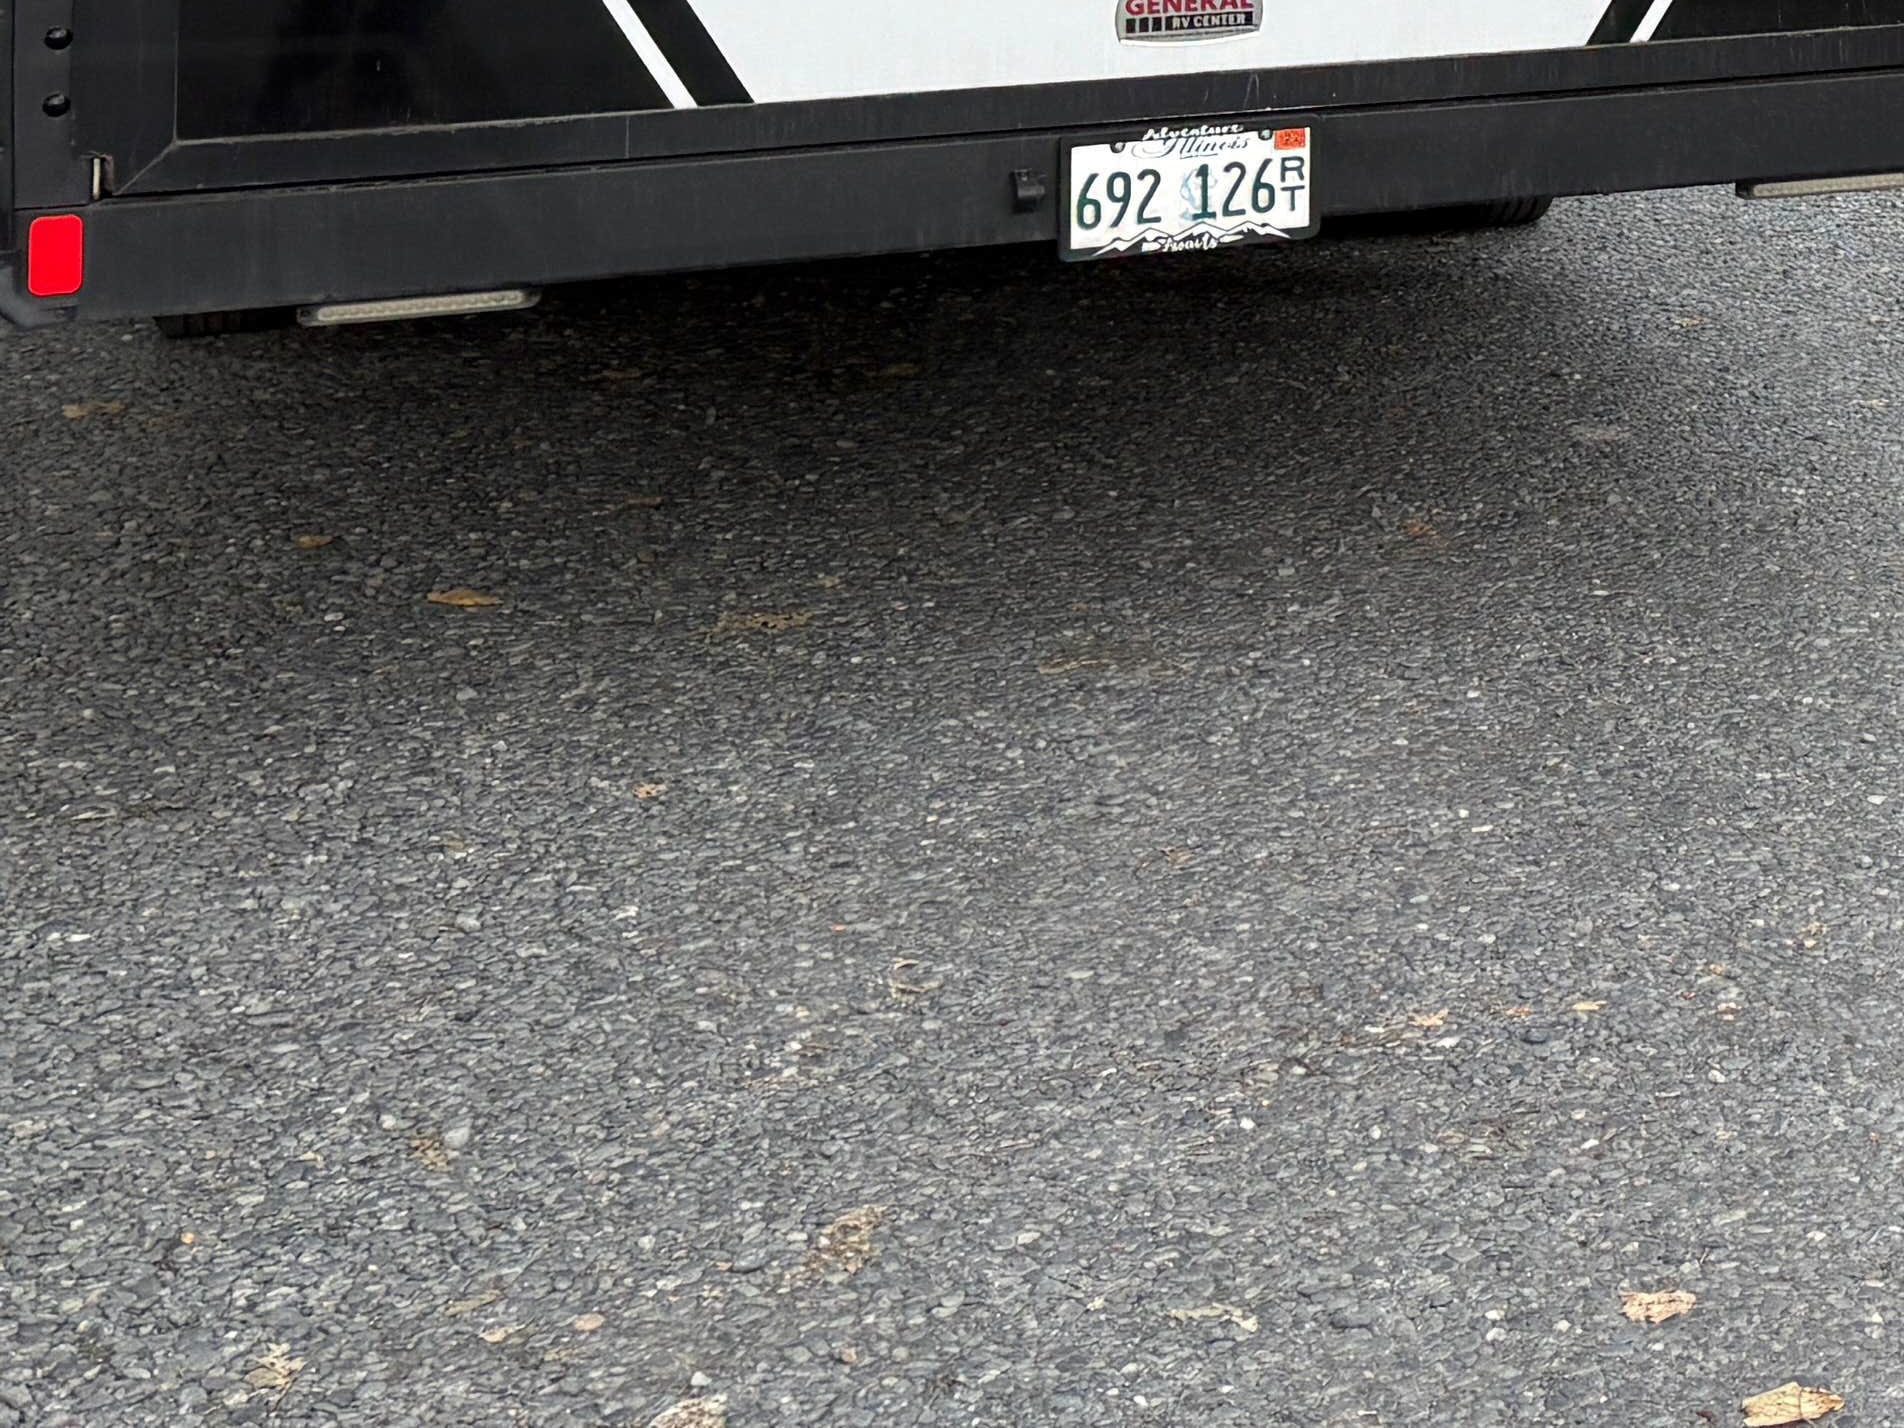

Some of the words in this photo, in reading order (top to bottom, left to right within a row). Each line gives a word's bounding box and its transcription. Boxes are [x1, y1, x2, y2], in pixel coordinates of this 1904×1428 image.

[1172, 16, 1191, 29] RV
[1193, 14, 1246, 28] CENTER
[1131, 134, 1251, 159] Illinois
[1076, 168, 1162, 230] 692
[1191, 158, 1276, 221] 126
